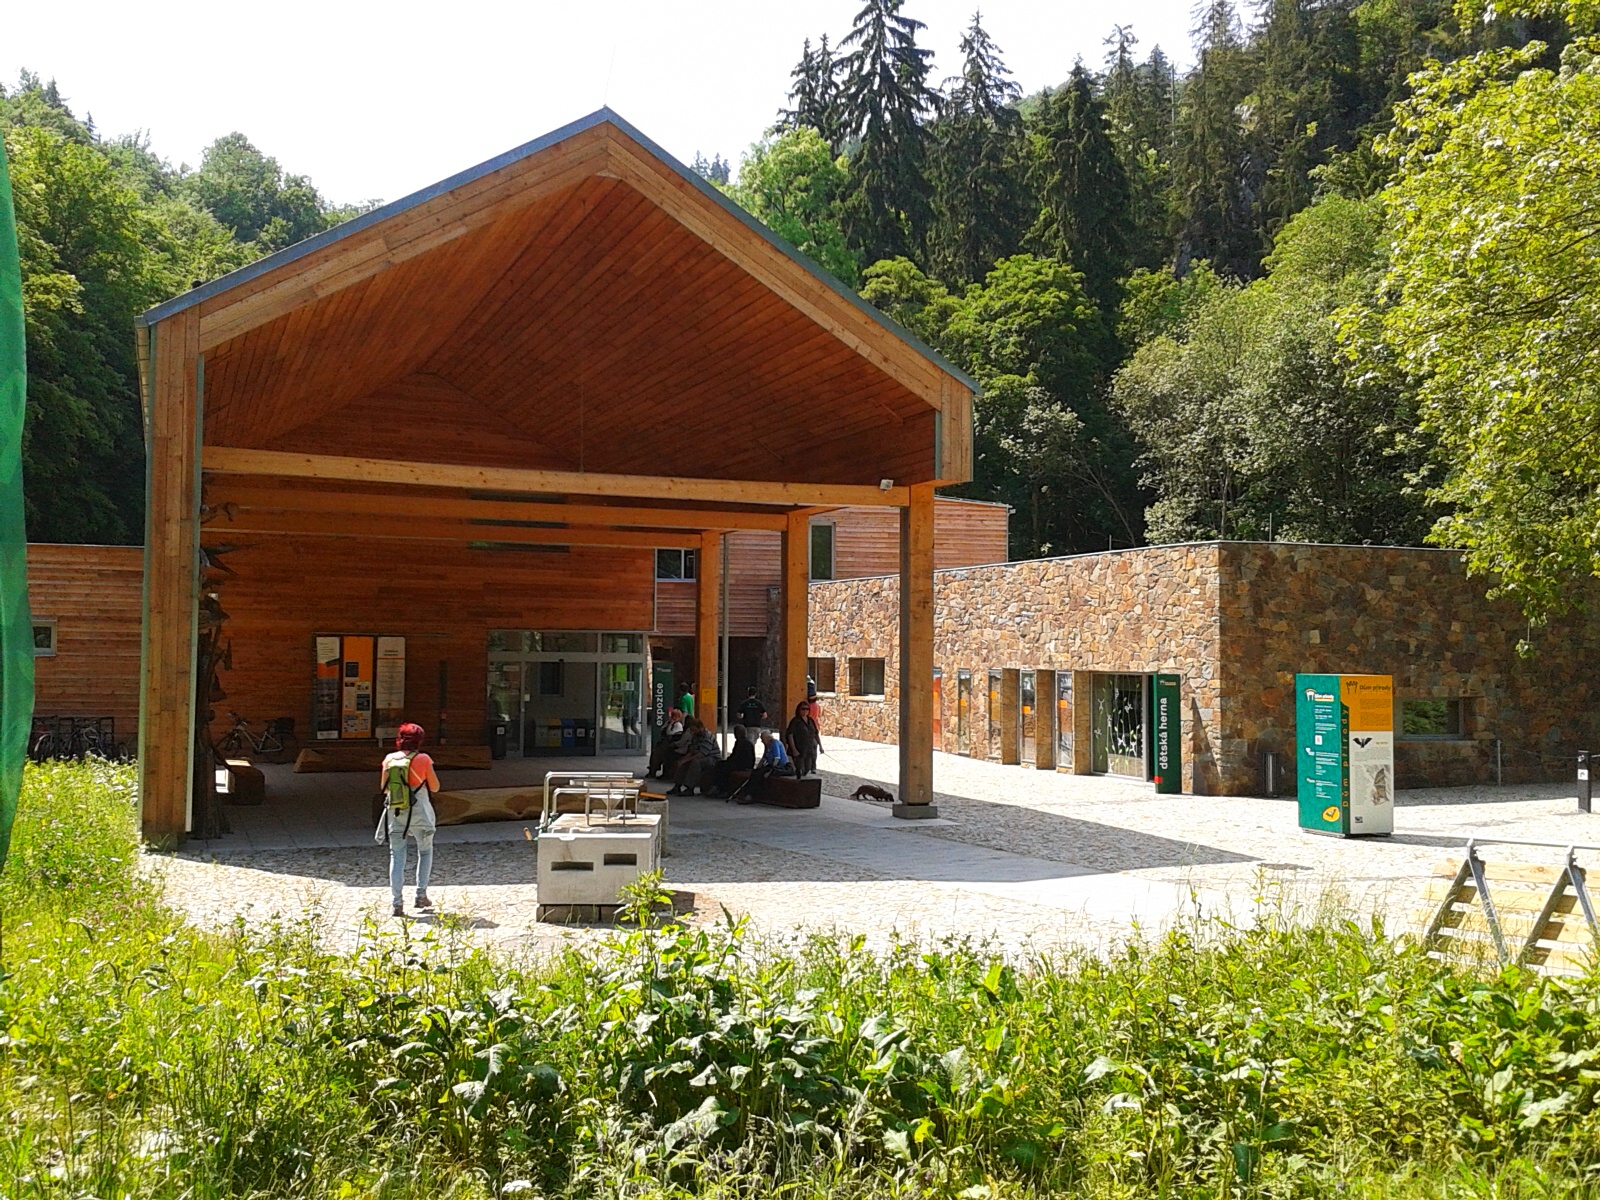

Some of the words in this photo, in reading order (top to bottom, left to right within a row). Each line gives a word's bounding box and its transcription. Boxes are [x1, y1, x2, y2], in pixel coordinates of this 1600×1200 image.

[655, 683, 665, 726] expozice
[1159, 698, 1168, 729] herna
[1159, 731, 1168, 770] dětská
